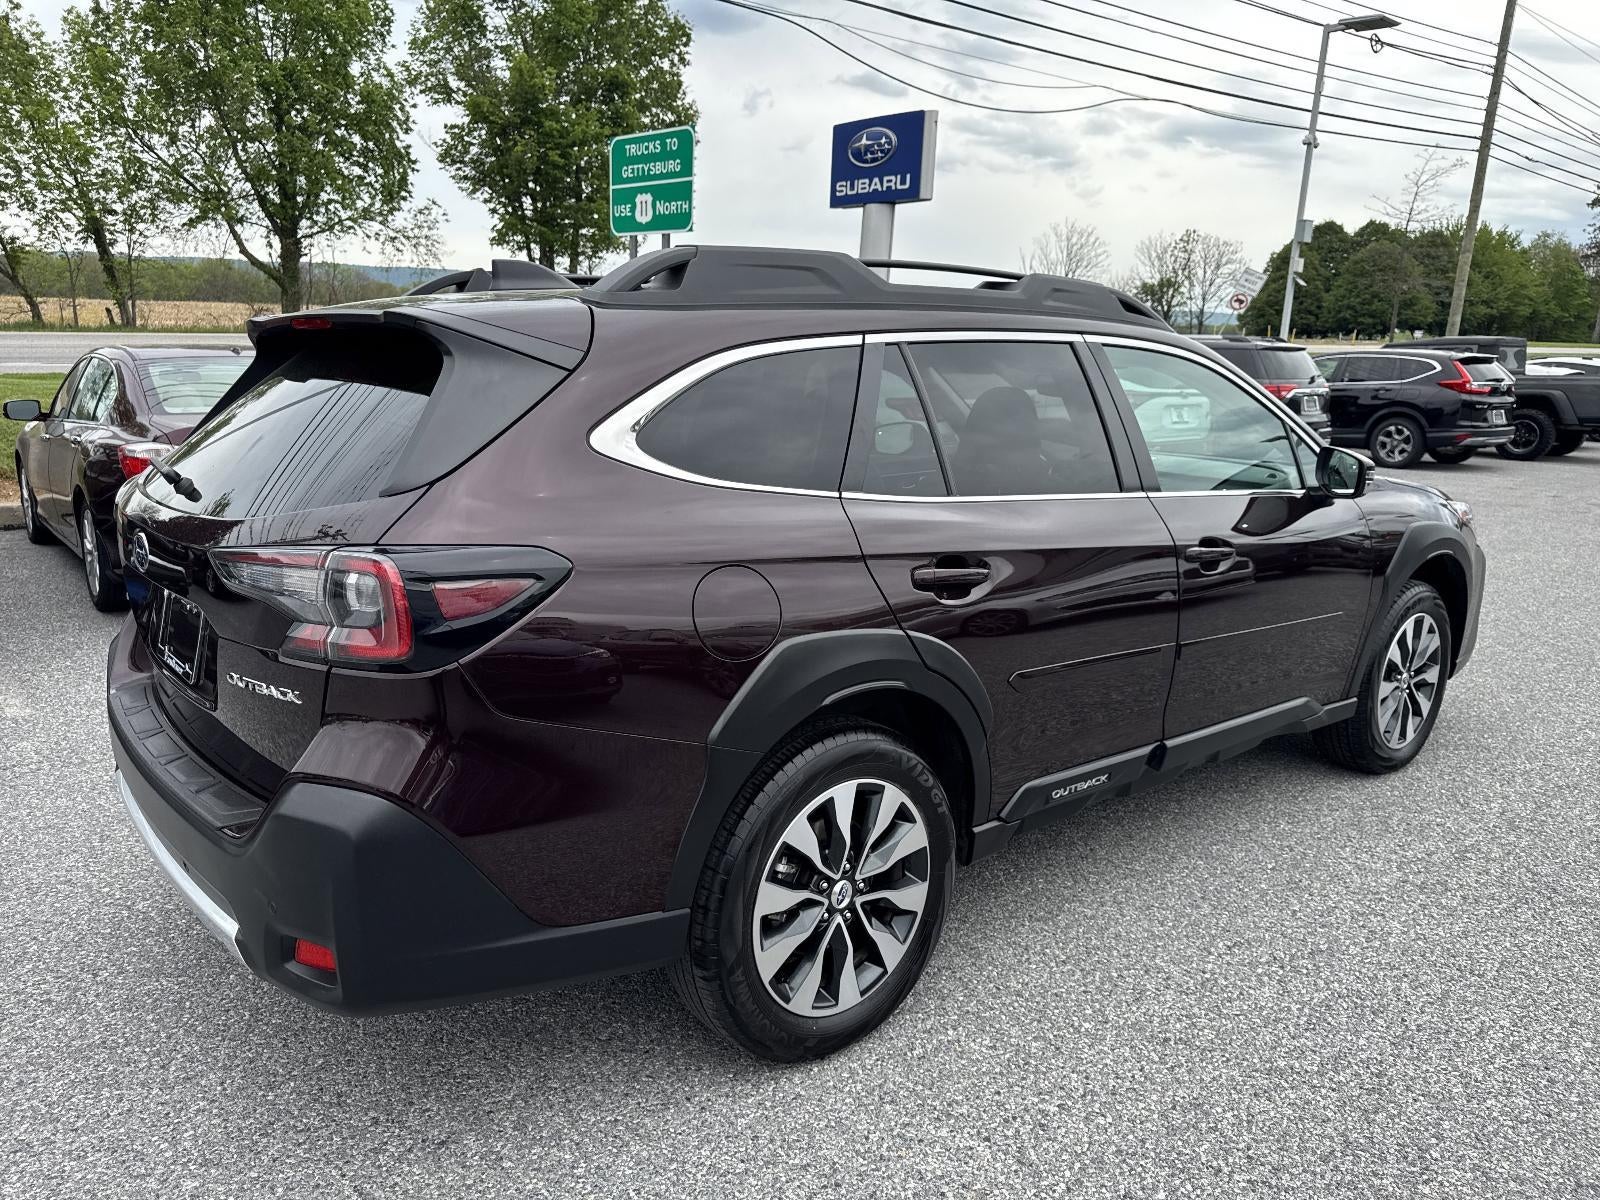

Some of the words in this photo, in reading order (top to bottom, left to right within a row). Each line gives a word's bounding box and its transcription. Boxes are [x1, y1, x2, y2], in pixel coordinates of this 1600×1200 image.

[625, 140, 661, 157] TRUCKS
[665, 137, 678, 151] TO
[621, 159, 681, 178] GETTYSBURG
[835, 173, 911, 197] SUBARU
[614, 204, 632, 217] USE
[640, 200, 648, 217] 11
[655, 200, 689, 216] NORTH
[226, 672, 303, 704] OUTBACK
[1051, 773, 1110, 799] OUTBACK
